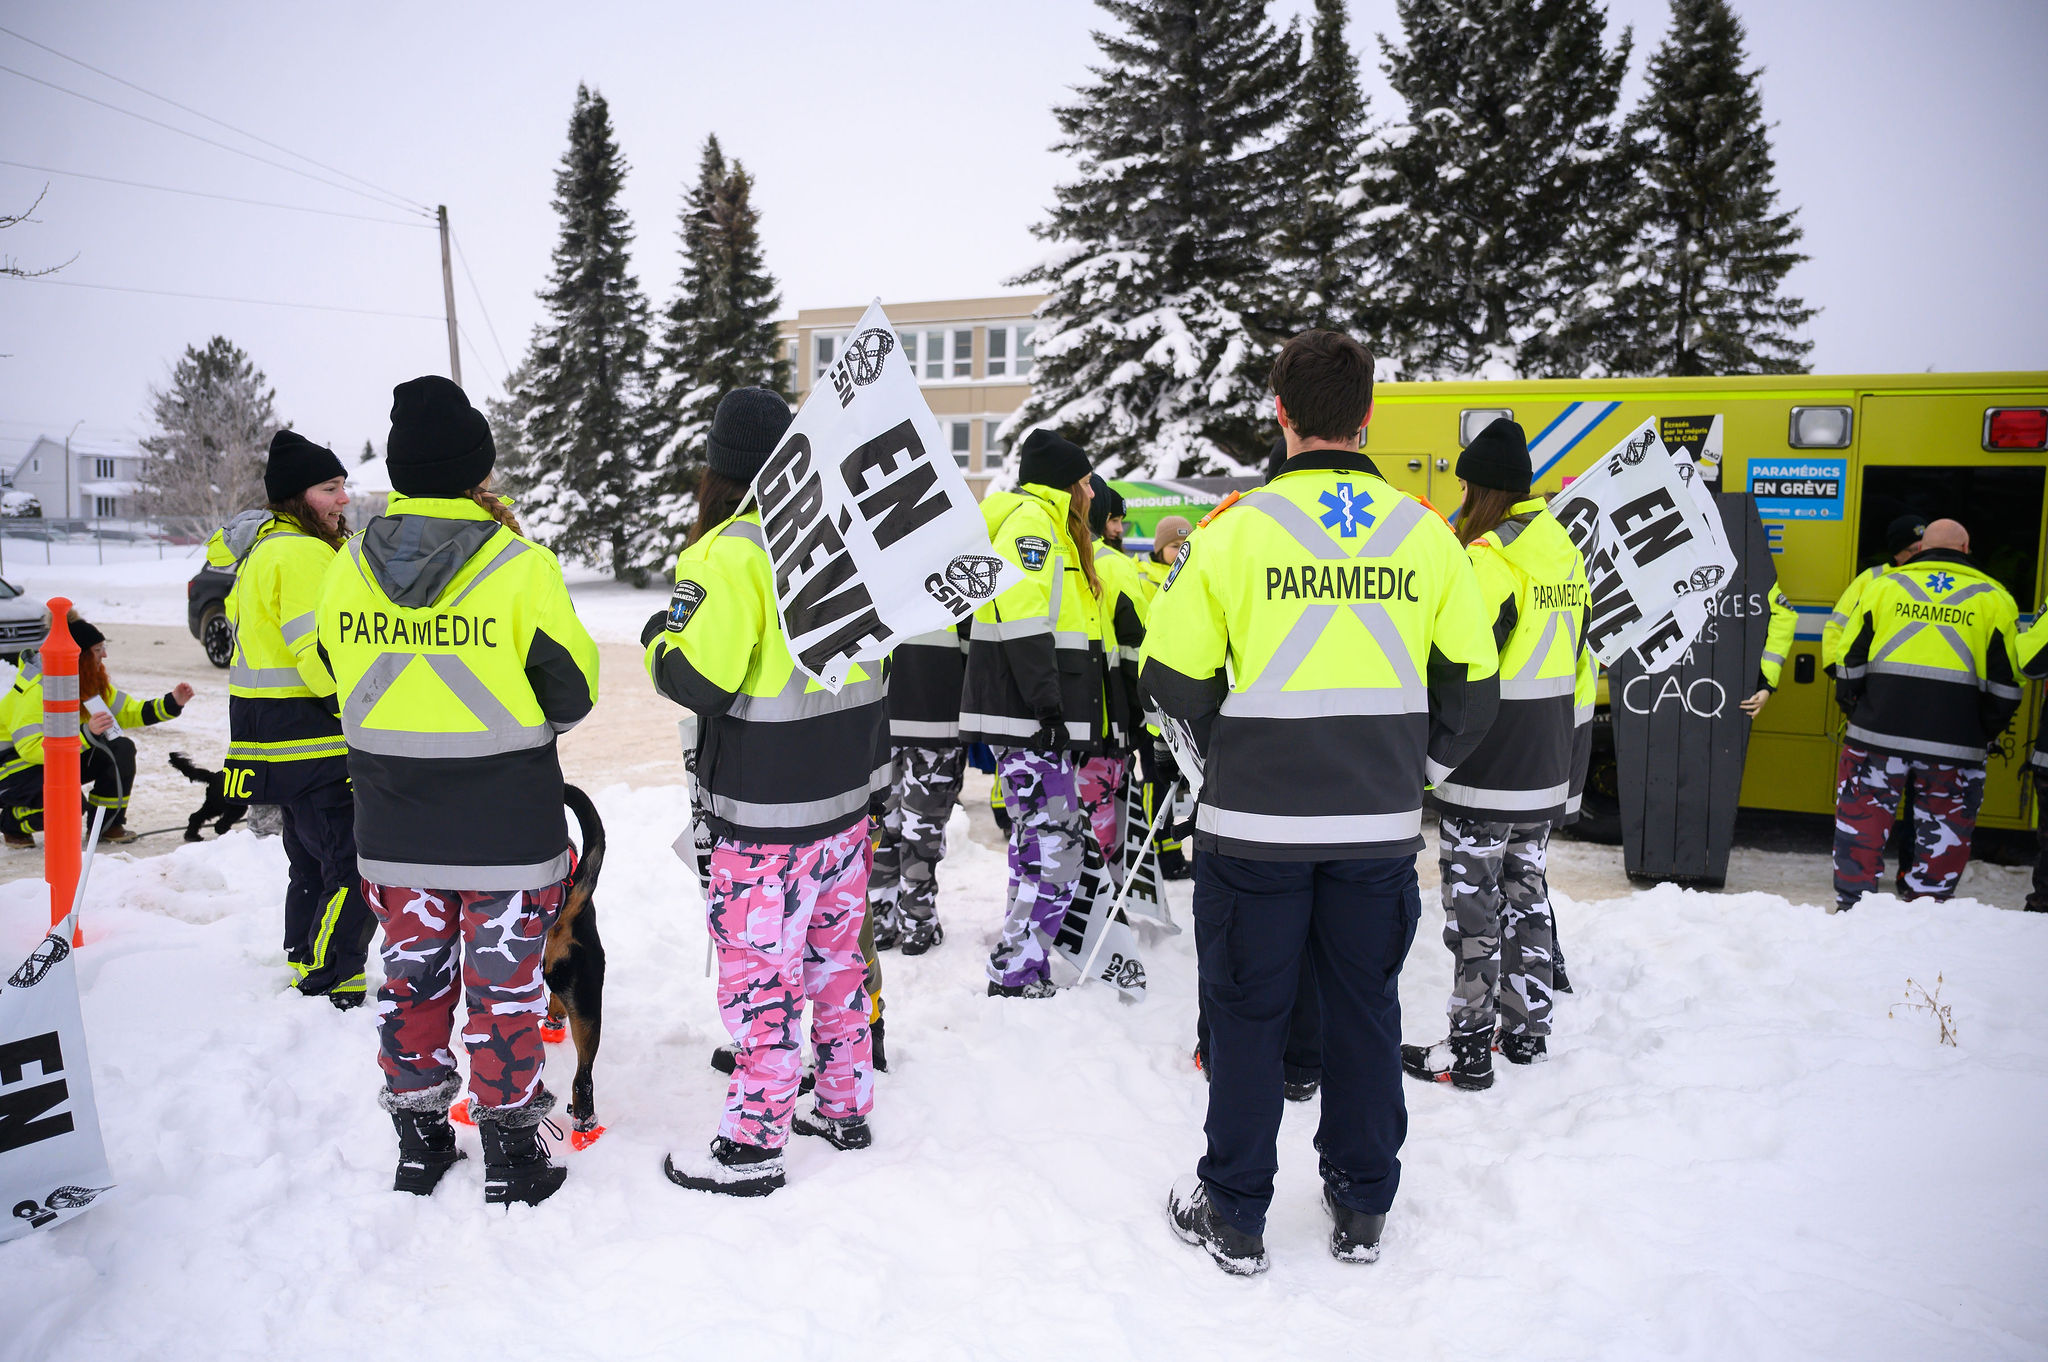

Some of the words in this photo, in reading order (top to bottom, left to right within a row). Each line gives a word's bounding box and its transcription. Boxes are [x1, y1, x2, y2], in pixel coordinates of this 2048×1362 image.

[839, 418, 953, 551] EN
[1752, 464, 1841, 477] PARAMÉDICS
[1753, 482, 1777, 495] EN
[1780, 480, 1838, 496] GRÈVE
[1609, 486, 1694, 568] EN
[757, 432, 894, 677] GRÈVE
[924, 572, 972, 618] CSN
[1266, 565, 1419, 603] PARAMEDIC
[1556, 497, 1643, 654] GÈVE
[339, 611, 497, 648] PARAMEDIC
[1894, 602, 1975, 627] PARAMEDIC
[1623, 675, 1726, 718] CAQ
[1101, 952, 1124, 983] CSN
